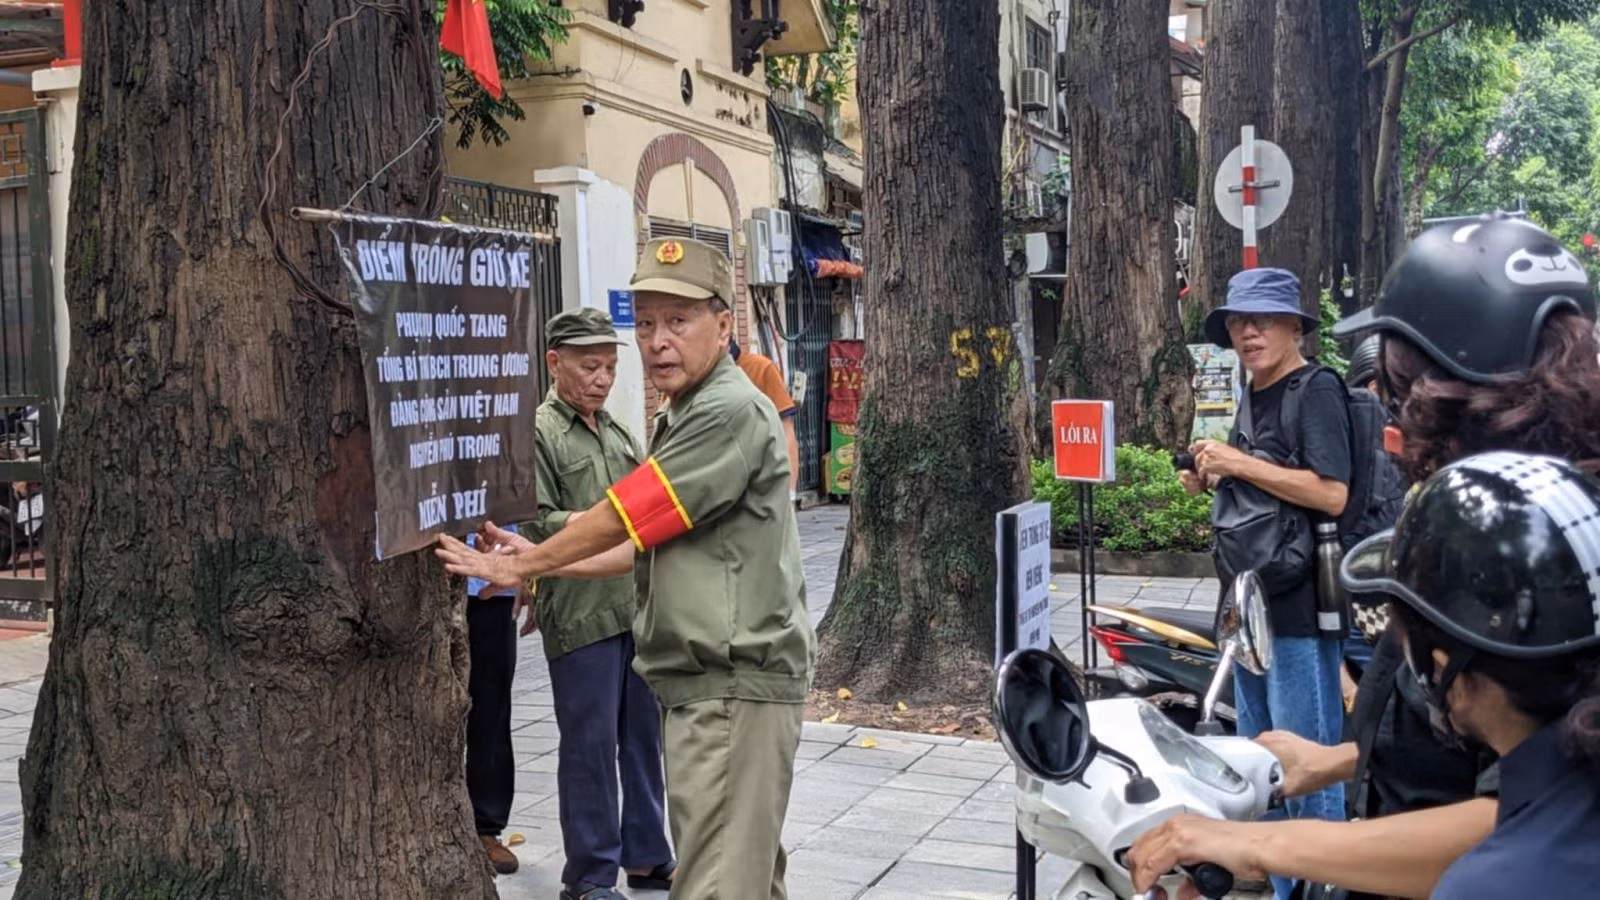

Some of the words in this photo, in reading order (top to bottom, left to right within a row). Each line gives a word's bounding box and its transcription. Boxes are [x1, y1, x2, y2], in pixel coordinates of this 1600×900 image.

[357, 224, 407, 282] ĐIỂM
[470, 243, 506, 288] GIỮ
[506, 251, 530, 289] XE
[435, 305, 465, 340] QUỐC
[470, 313, 507, 338] TANG
[376, 346, 404, 383] TỔNG
[404, 350, 417, 381] BÍ
[430, 354, 451, 380] BCH
[452, 353, 499, 379] TRUNG
[502, 352, 529, 377] ƯƠNG
[390, 392, 419, 427] ĐẢNG
[437, 388, 457, 421] SẢN
[459, 390, 492, 424] VIỆT
[494, 393, 519, 417] NAM
[457, 433, 500, 463] TRỌNG
[1082, 426, 1098, 445] RA
[452, 480, 487, 520] PHÍ
